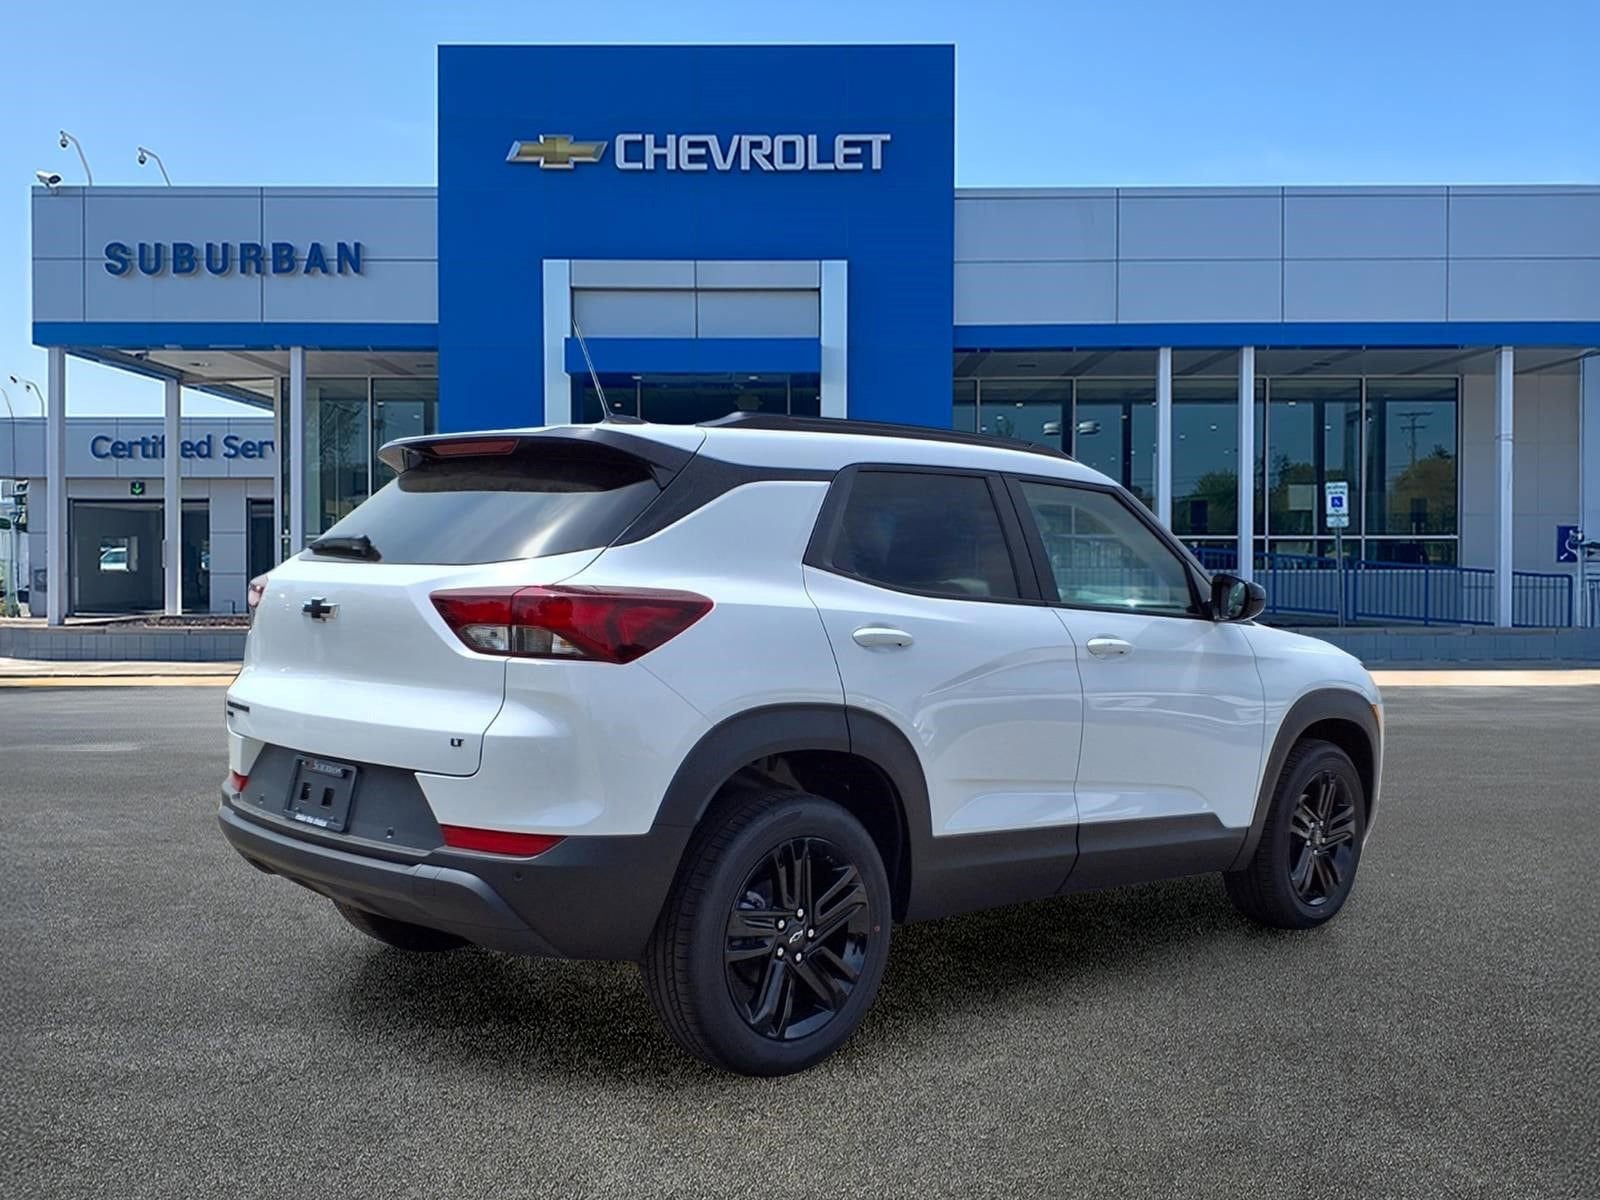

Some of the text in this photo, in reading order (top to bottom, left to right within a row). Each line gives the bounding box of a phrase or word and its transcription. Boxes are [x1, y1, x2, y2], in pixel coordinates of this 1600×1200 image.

[615, 133, 891, 172] CHEVROLET
[104, 242, 362, 275] SUBURBAN
[91, 434, 212, 459] Certifed
[450, 738, 465, 748] LT
